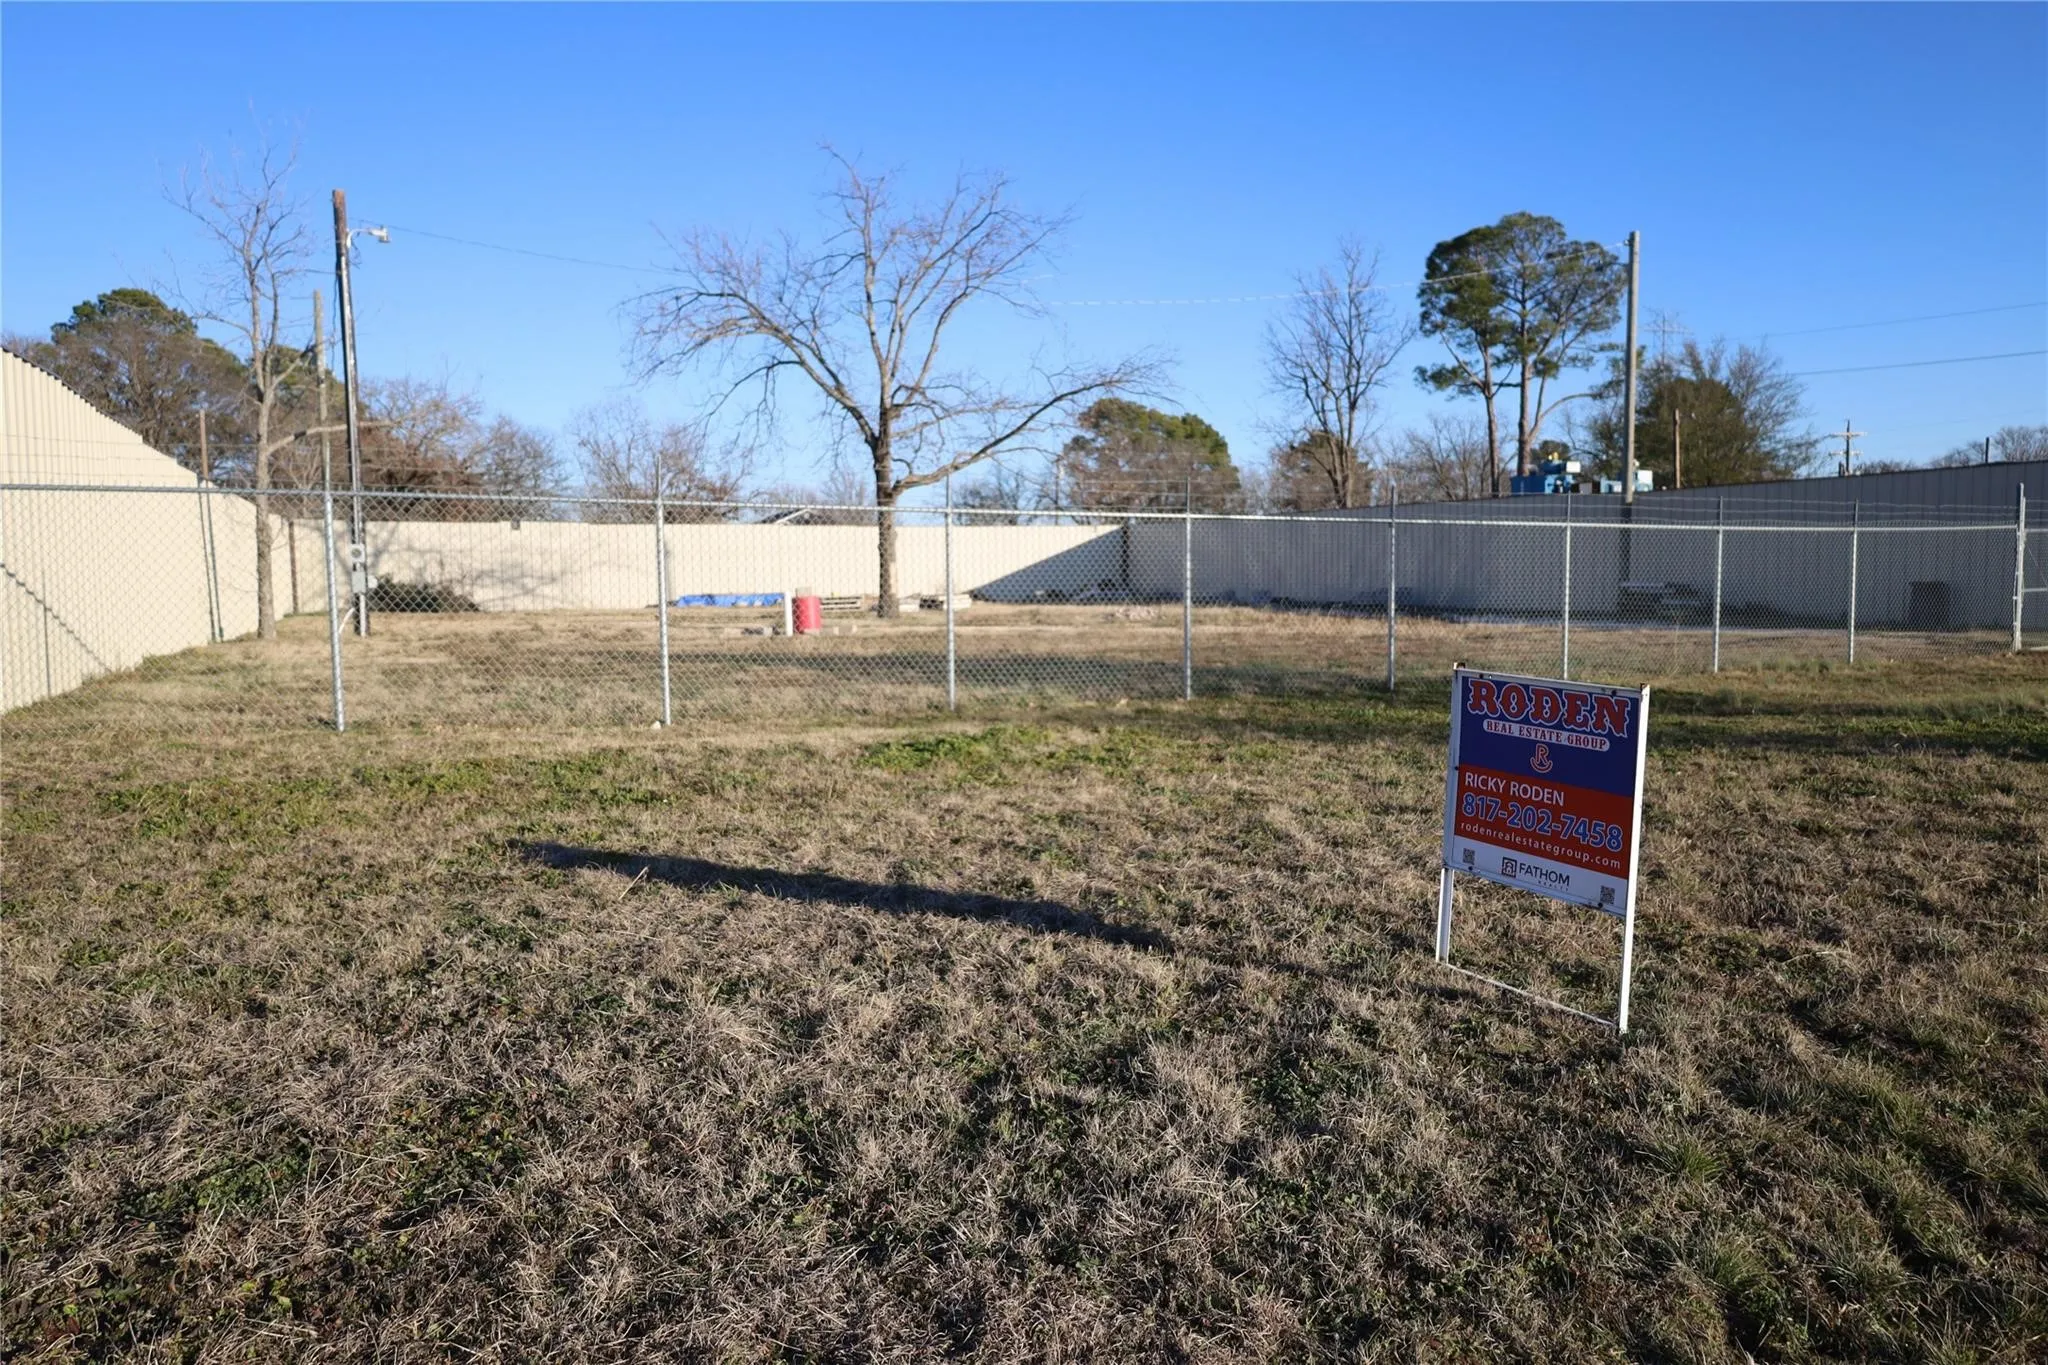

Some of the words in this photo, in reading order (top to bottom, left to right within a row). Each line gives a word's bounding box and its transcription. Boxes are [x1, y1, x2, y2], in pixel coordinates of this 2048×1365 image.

[1467, 679, 1631, 738] RODEN
[1486, 720, 1513, 735] REAL
[1519, 725, 1562, 742] ESTATE
[1567, 735, 1607, 750] GROUP
[1464, 772, 1506, 793] RICKY
[1510, 782, 1564, 806] RODEN
[1462, 792, 1623, 851] 817-202-7458
[1461, 822, 1621, 869] rodenrealestategroup.com
[1519, 863, 1570, 886] FATHOM
